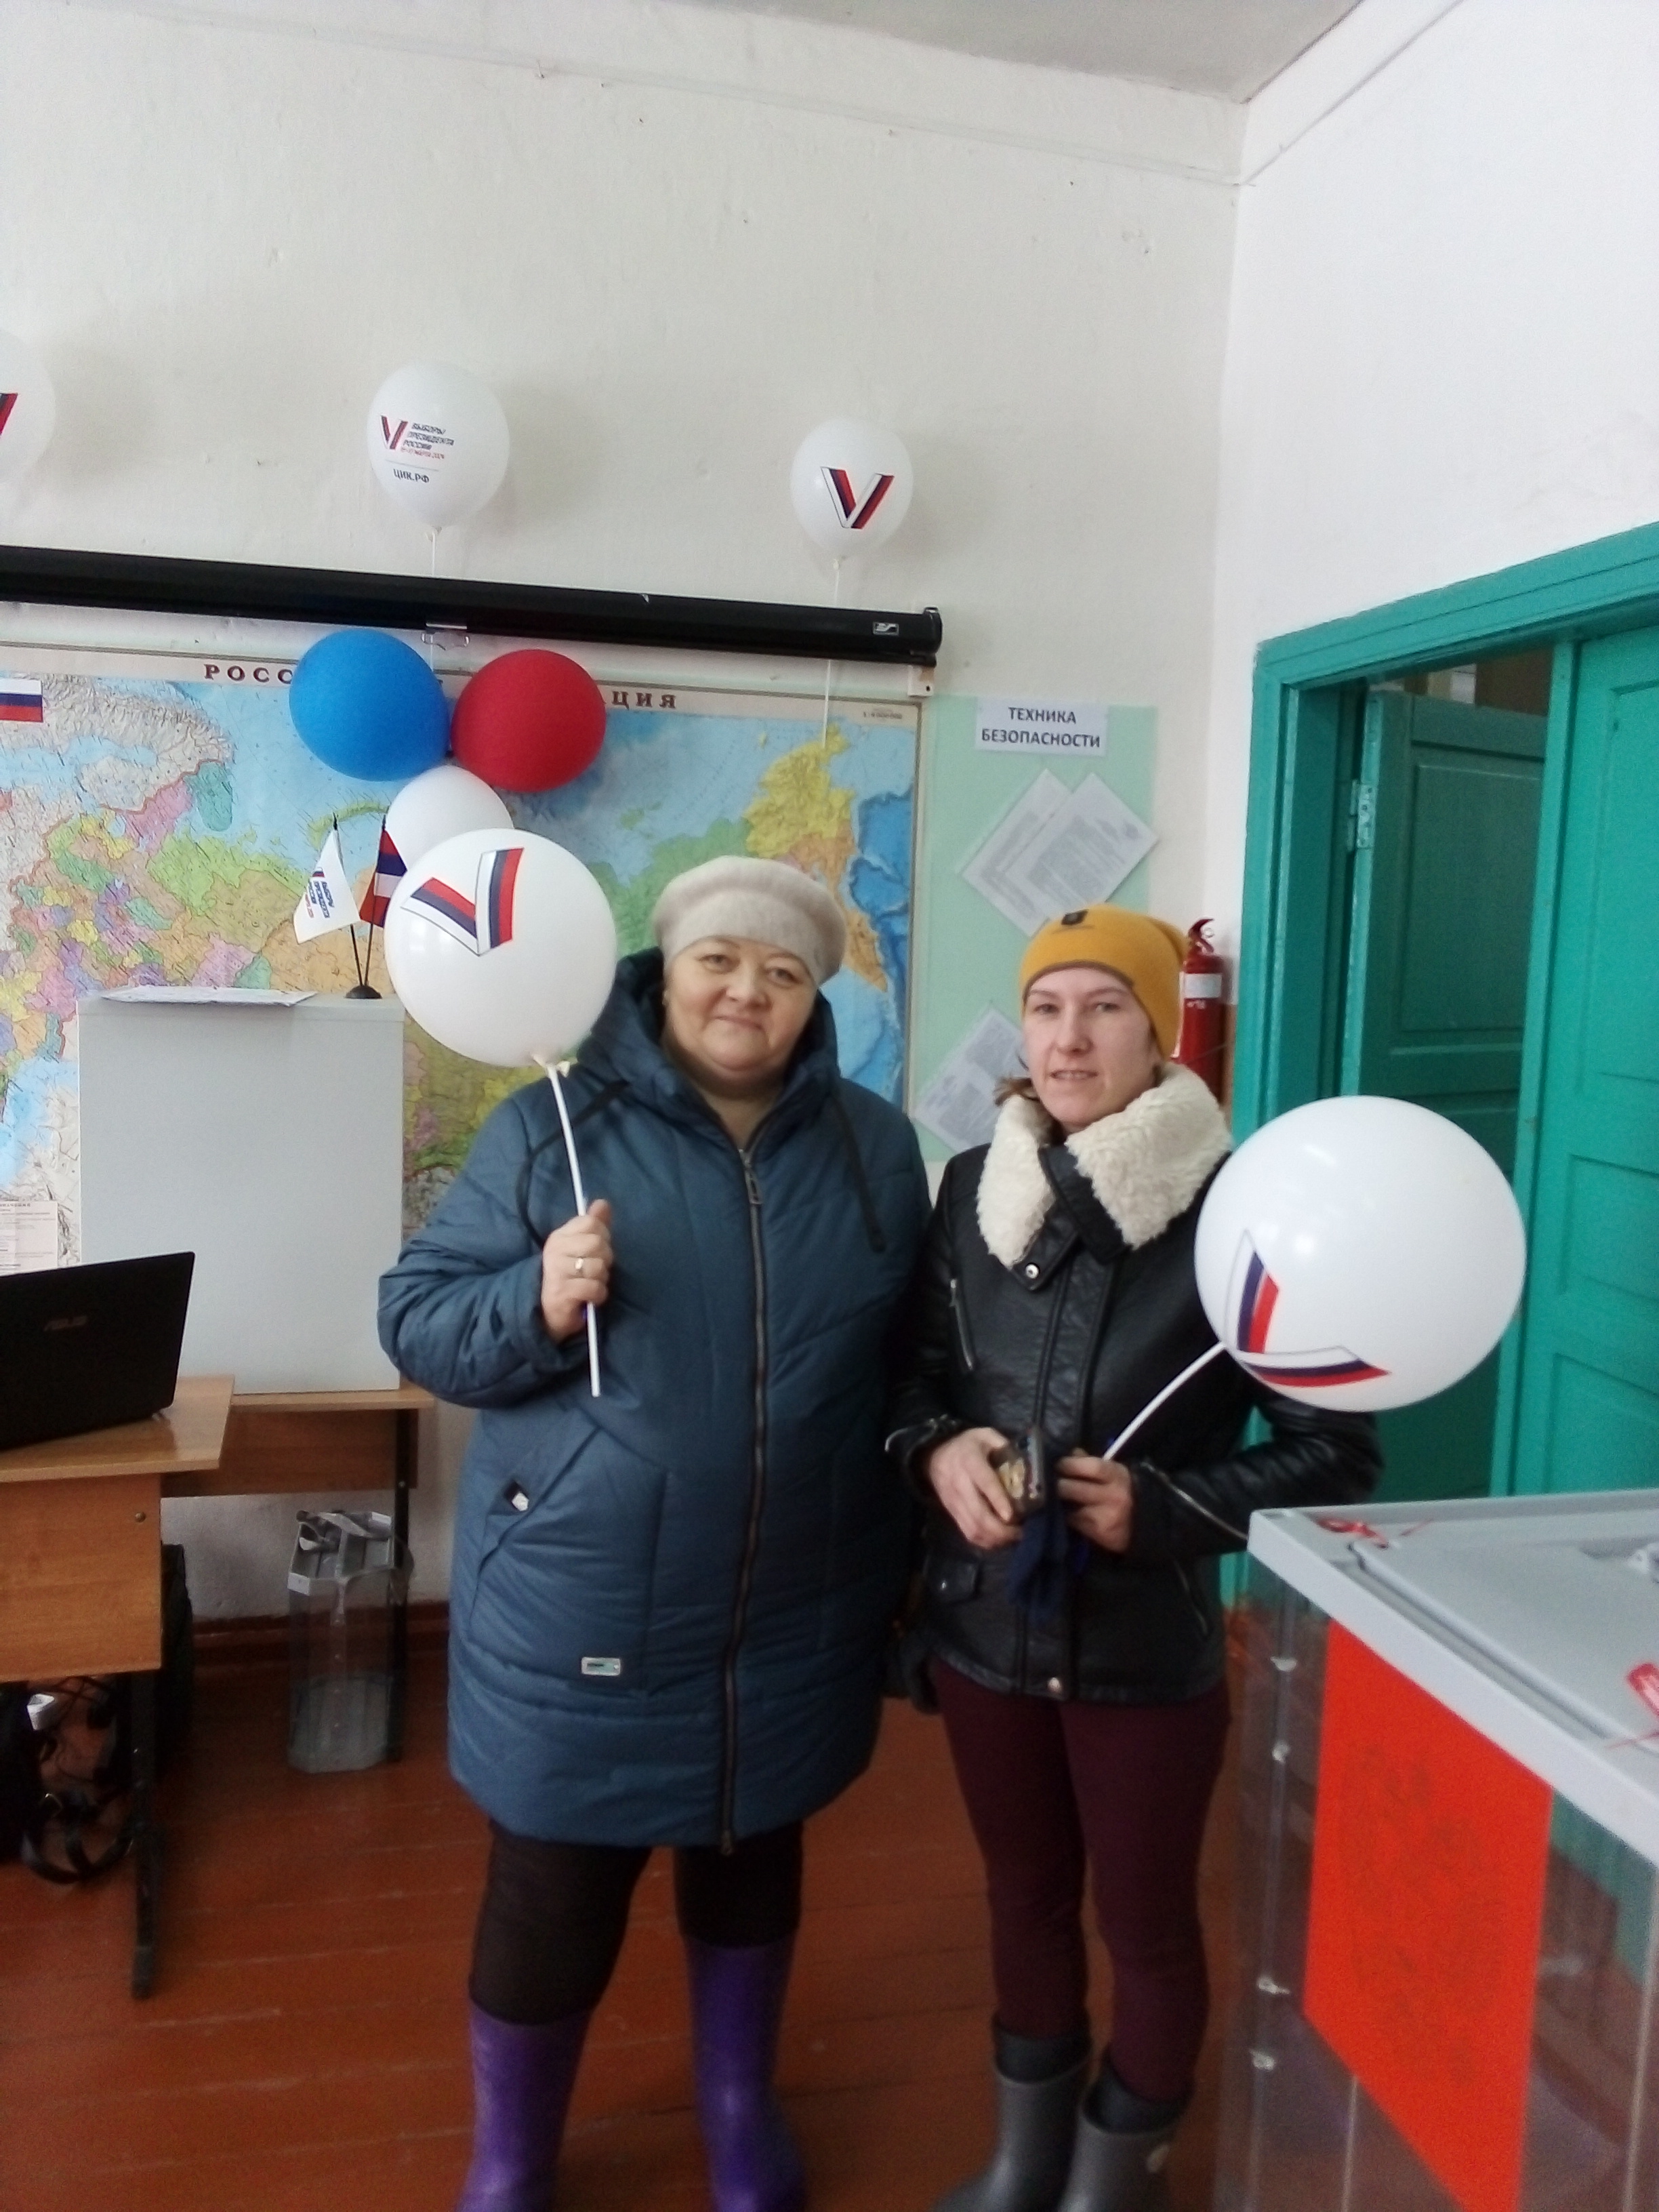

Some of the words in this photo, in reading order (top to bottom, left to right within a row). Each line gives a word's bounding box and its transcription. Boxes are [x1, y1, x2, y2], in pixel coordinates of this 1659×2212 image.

[393, 468, 430, 483] ЦИК.РФ
[203, 663, 293, 684] РОСС
[610, 690, 676, 711] ЦИЯ
[1008, 706, 1077, 724] ТЕХНИКА
[981, 728, 1100, 748] БЕЗОПАСНОСТИ
